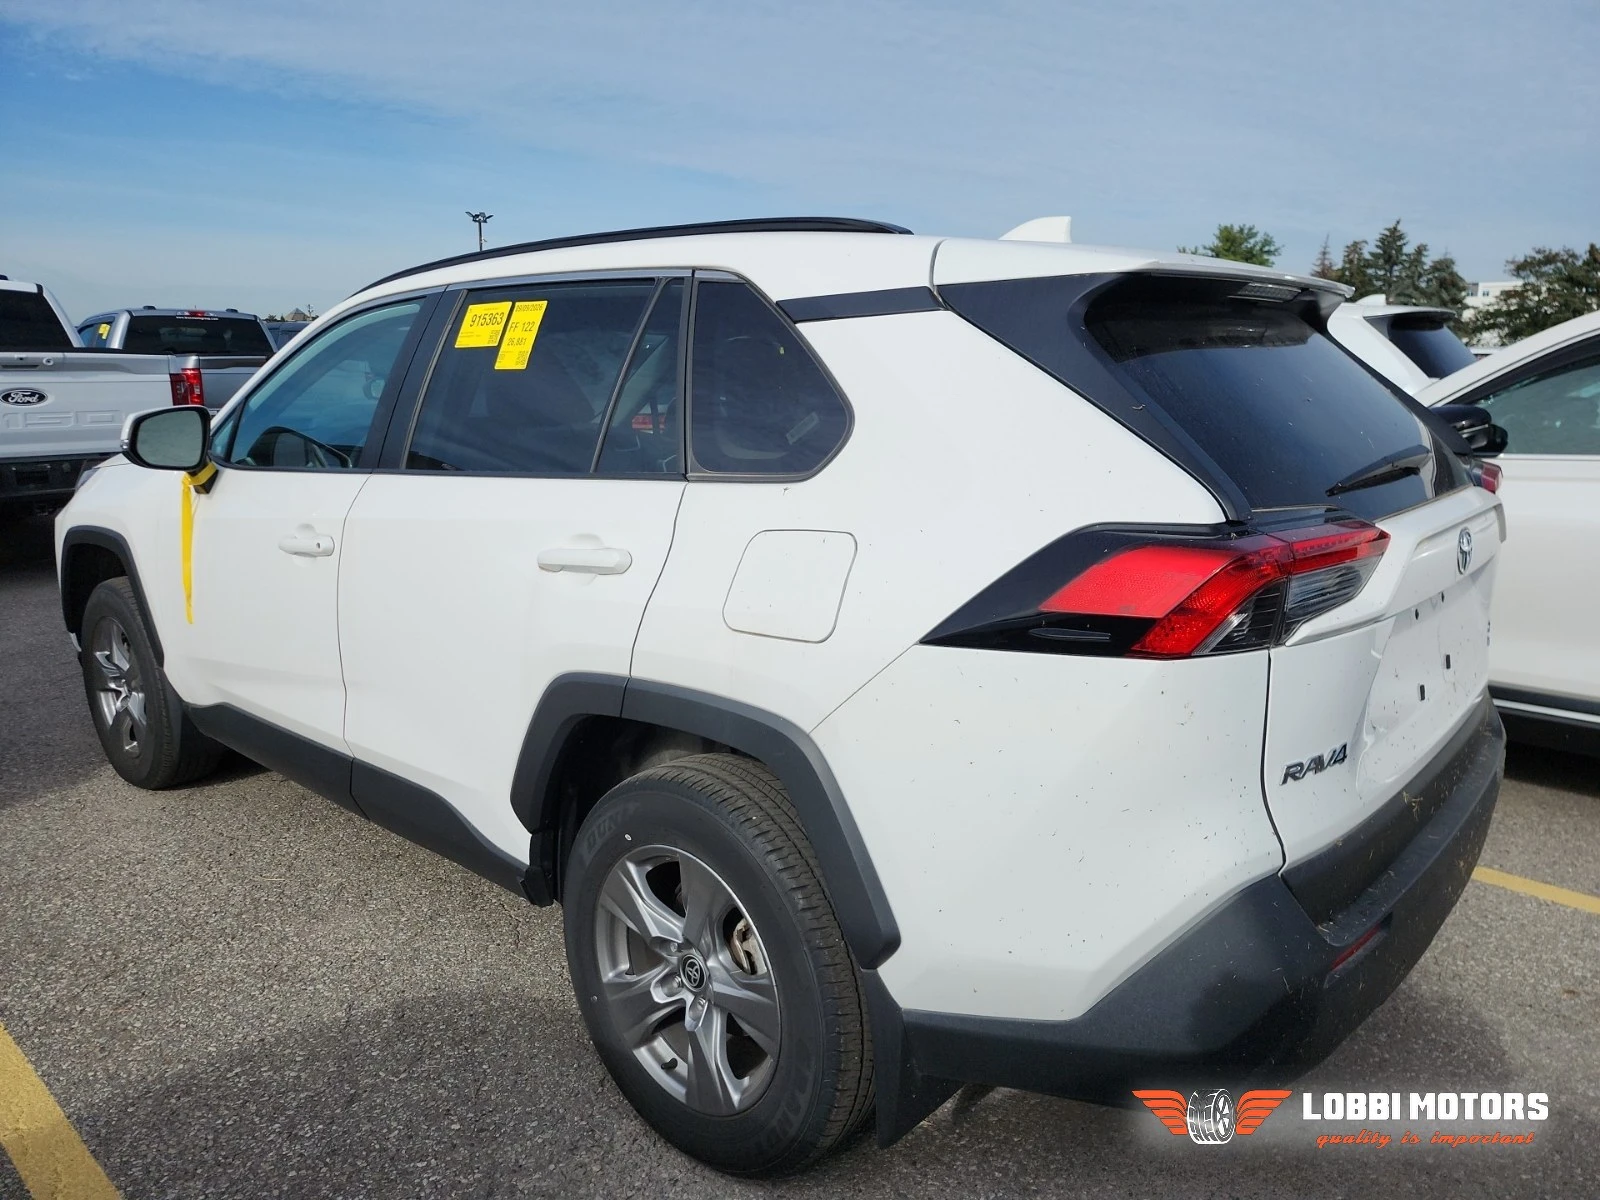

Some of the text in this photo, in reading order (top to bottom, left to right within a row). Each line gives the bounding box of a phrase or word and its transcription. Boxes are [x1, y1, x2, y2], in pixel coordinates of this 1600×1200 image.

[470, 312, 504, 327] 915363
[508, 321, 535, 332] FF 122
[8, 390, 39, 404] Ford
[1280, 742, 1348, 786] RAV4
